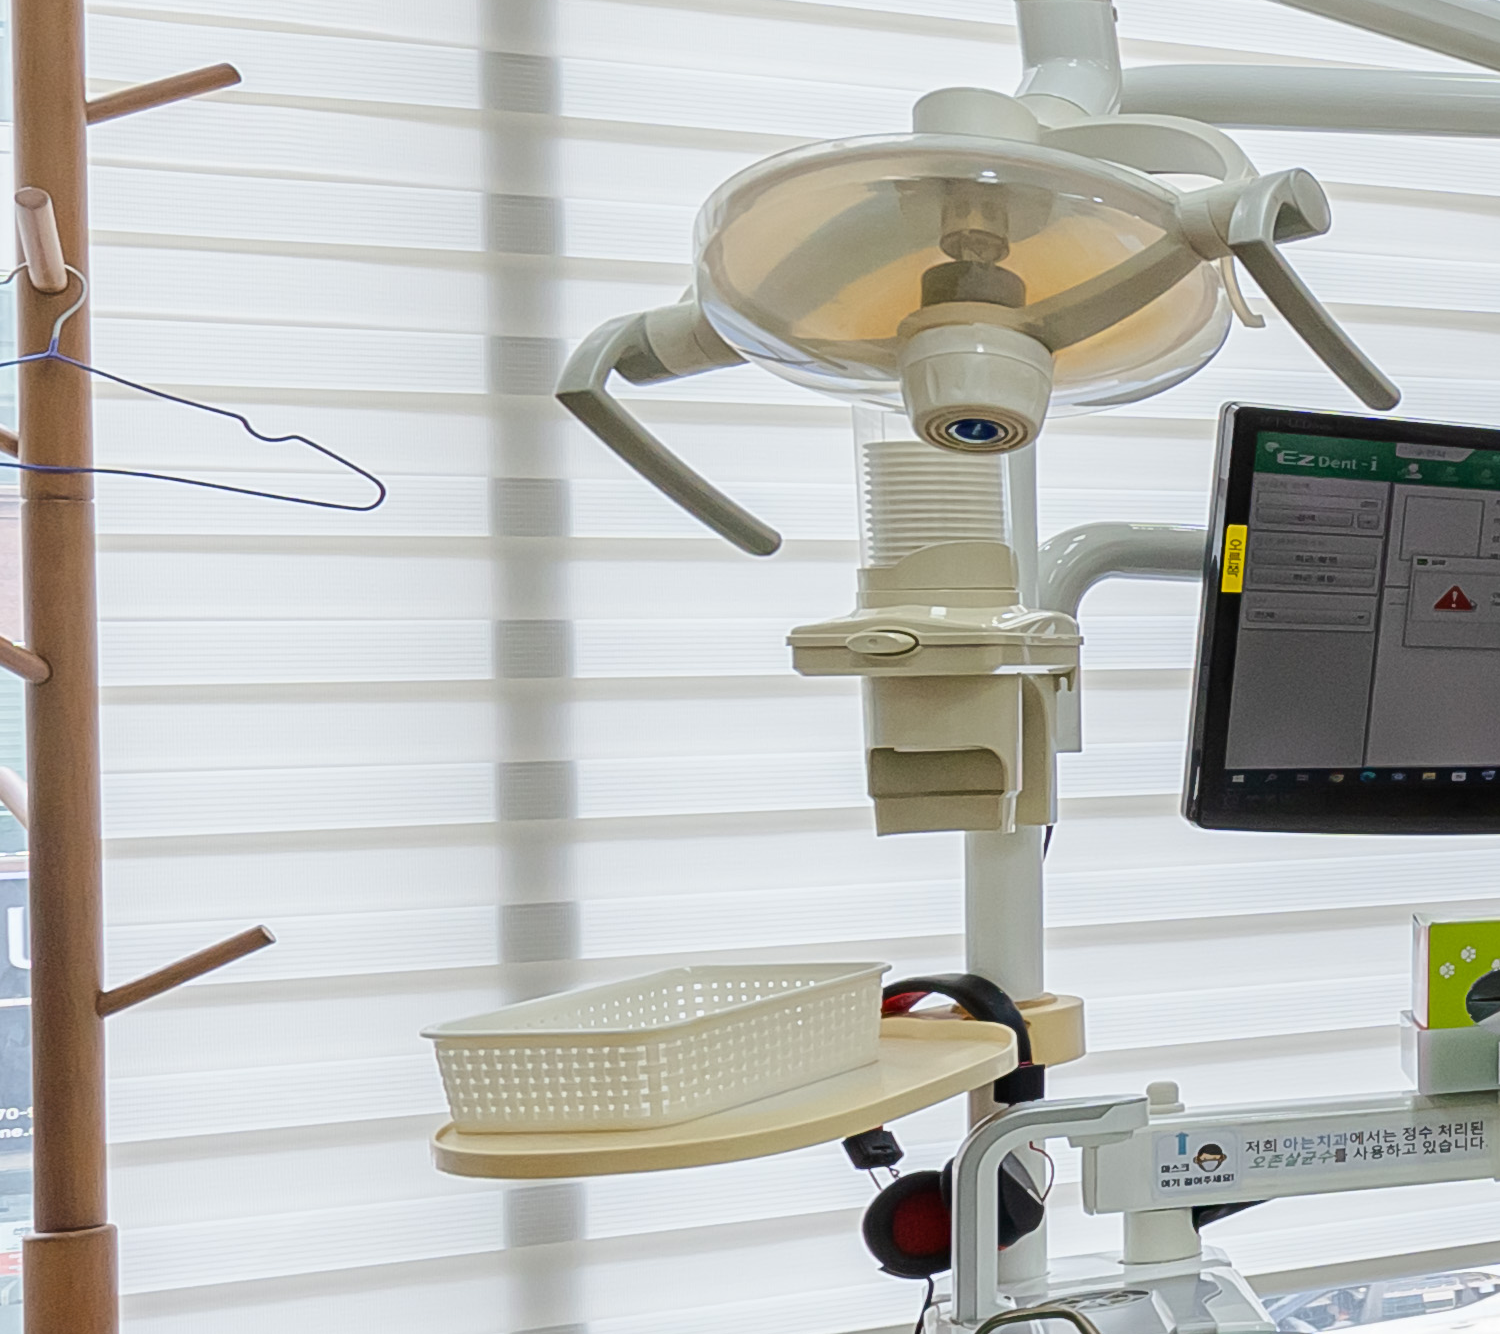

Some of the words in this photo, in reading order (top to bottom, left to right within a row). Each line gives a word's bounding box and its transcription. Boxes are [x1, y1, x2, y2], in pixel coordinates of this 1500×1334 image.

[1245, 1138, 1278, 1154] 저희
[1283, 1128, 1397, 1151] 아는치과에서는
[1402, 1125, 1433, 1142] 정수
[1438, 1120, 1485, 1138] 처리된
[1249, 1147, 1348, 1169] 오존살균수를
[1353, 1142, 1418, 1161] 사용하고
[1423, 1136, 1489, 1155] 있습니다.
[1160, 1163, 1190, 1175] 마스크
[1160, 1178, 1181, 1189] 여기
[1184, 1173, 1235, 1187] 걸어주세요!
